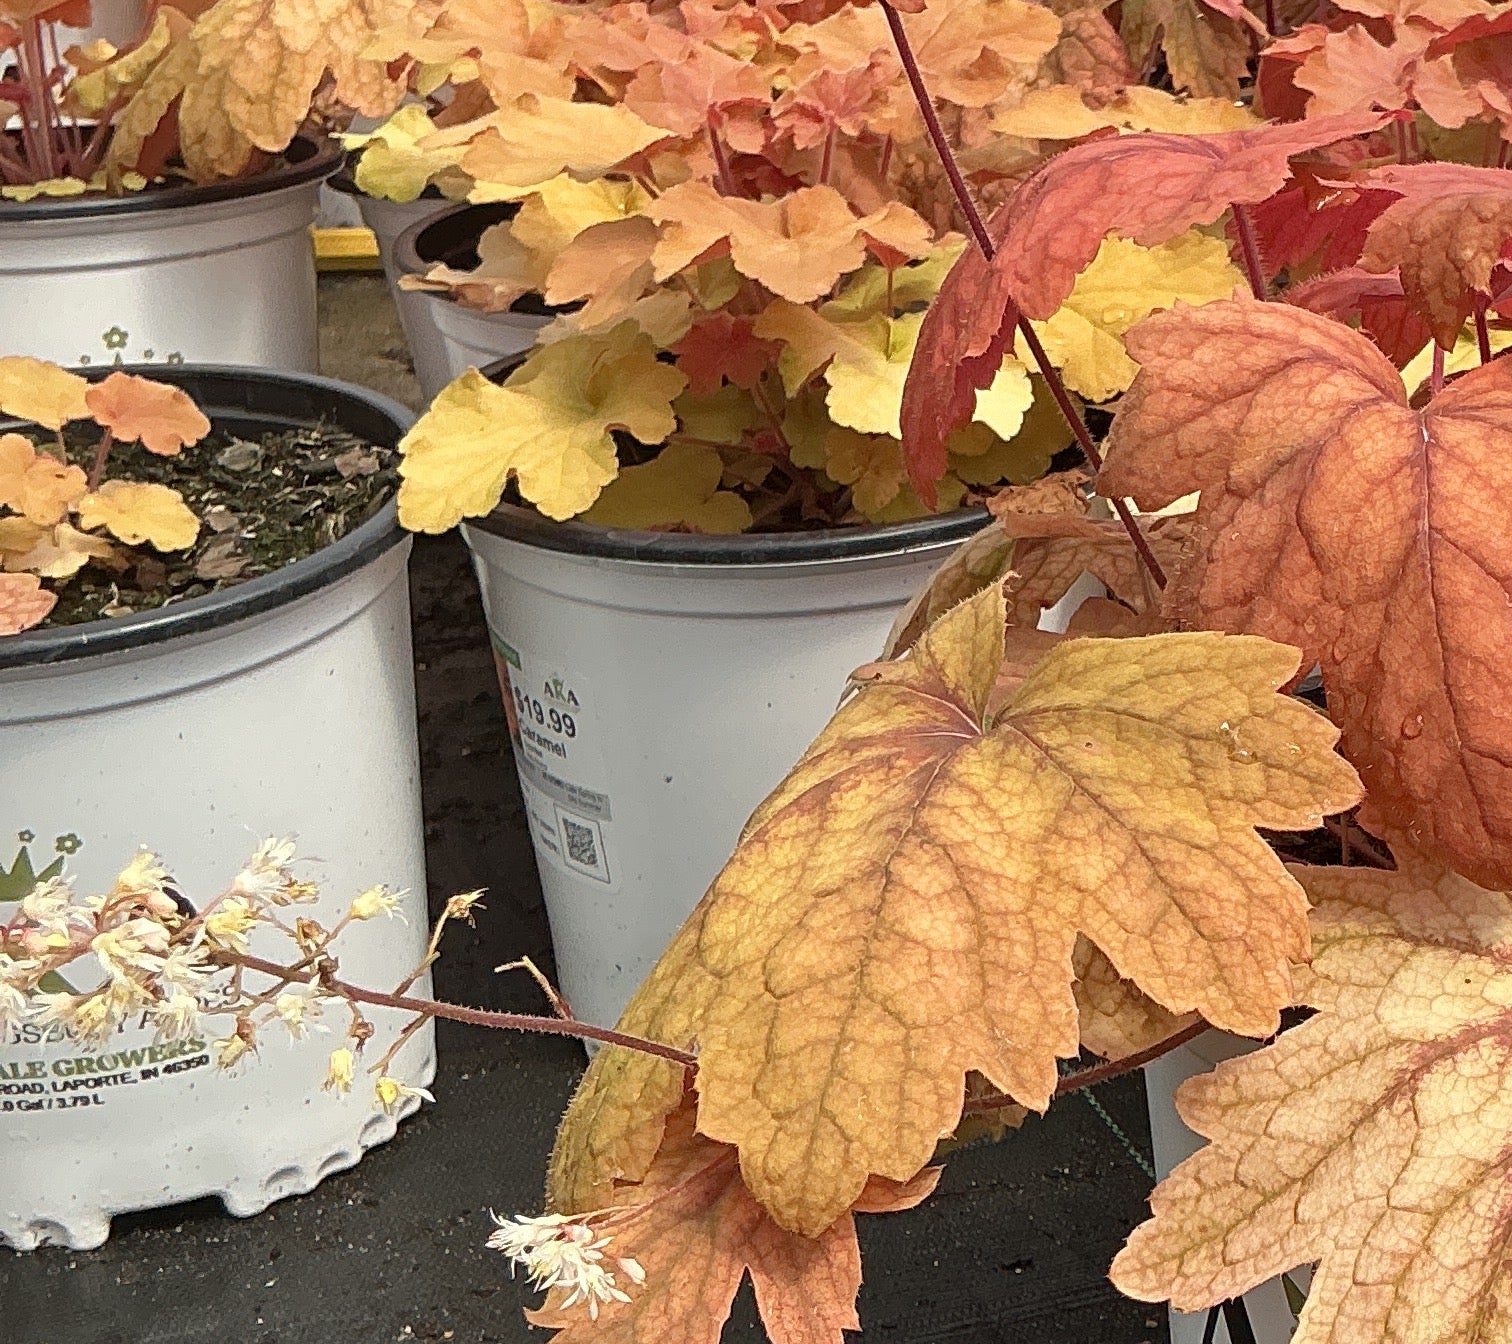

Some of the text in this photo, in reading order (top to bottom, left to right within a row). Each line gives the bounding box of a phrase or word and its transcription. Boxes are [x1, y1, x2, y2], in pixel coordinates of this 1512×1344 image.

[514, 686, 577, 738] $19.99
[51, 1071, 139, 1093] LAPORTE,
[140, 1066, 160, 1081] IN
[93, 1093, 106, 1106] L
